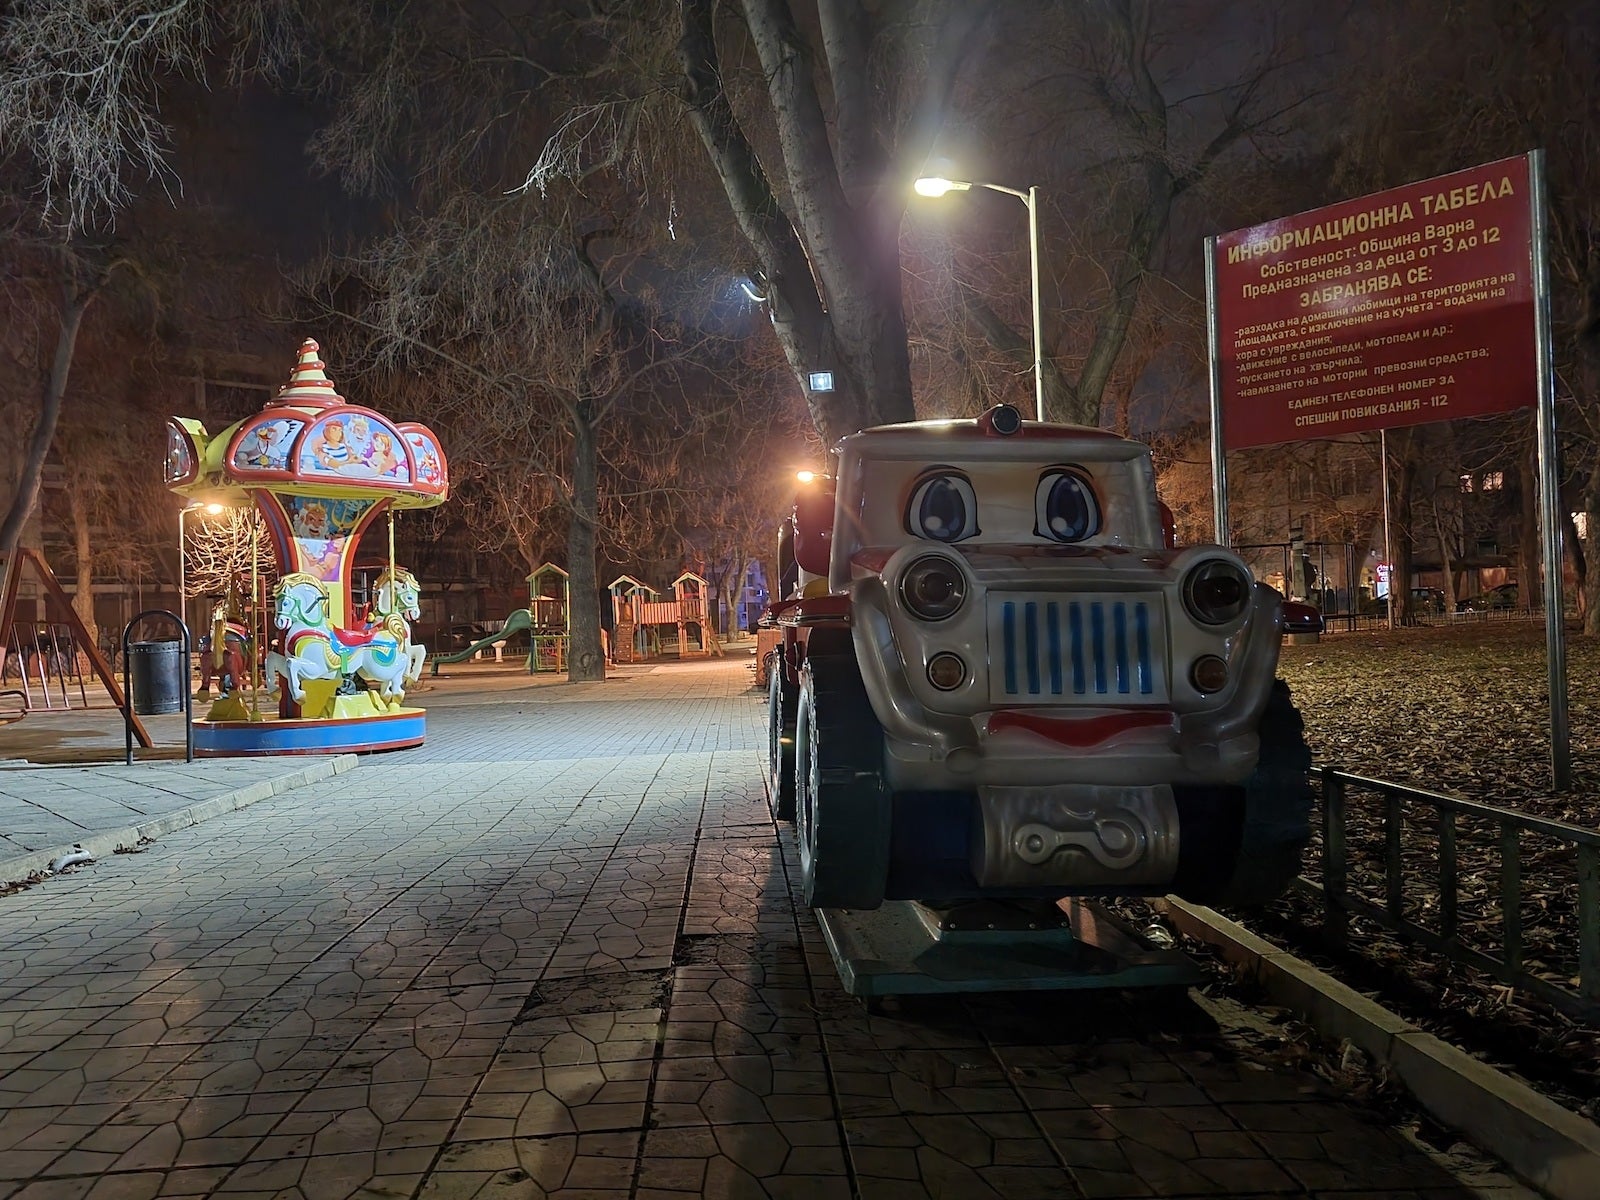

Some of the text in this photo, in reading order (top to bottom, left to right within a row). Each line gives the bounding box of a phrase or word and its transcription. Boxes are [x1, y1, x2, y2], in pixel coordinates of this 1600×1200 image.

[1228, 176, 1514, 264] ИНФОРМАЦИОННА ТАБЕЛА
[1243, 227, 1500, 299] Предназначена за деца от 3 до 12
[1260, 219, 1475, 278] Собственост: Община Варна
[1287, 318, 1299, 326] на
[1301, 308, 1348, 325] домашни
[1352, 296, 1400, 312] любимци
[1404, 293, 1418, 302] на
[1420, 276, 1498, 299] територията
[1500, 272, 1516, 284] на
[1300, 266, 1432, 307] ЗАБРАНЯВА СЕ:
[1300, 326, 1306, 334] с
[1309, 314, 1373, 334] изключение
[1376, 310, 1390, 320] на
[1392, 301, 1434, 318] кучета
[1444, 290, 1488, 307] водачи
[1490, 287, 1506, 298] на
[1236, 348, 1258, 361] хора
[1260, 348, 1266, 356] с
[1291, 354, 1297, 362] с
[1366, 329, 1420, 347] мотопеди
[1422, 328, 1430, 338] и
[1294, 365, 1306, 374] на
[1306, 377, 1318, 386] на
[1322, 368, 1368, 383] моторни
[1374, 359, 1427, 376] превозни
[1428, 348, 1490, 367] средства;
[1288, 375, 1455, 410] ЕДИНЕН ТЕЛЕФОНЕН НОМЕР ЗА
[1296, 410, 1340, 426] СПЕШНИ
[1342, 399, 1420, 420] ПОВИКВАНИЯ
[1431, 394, 1448, 407] 112
